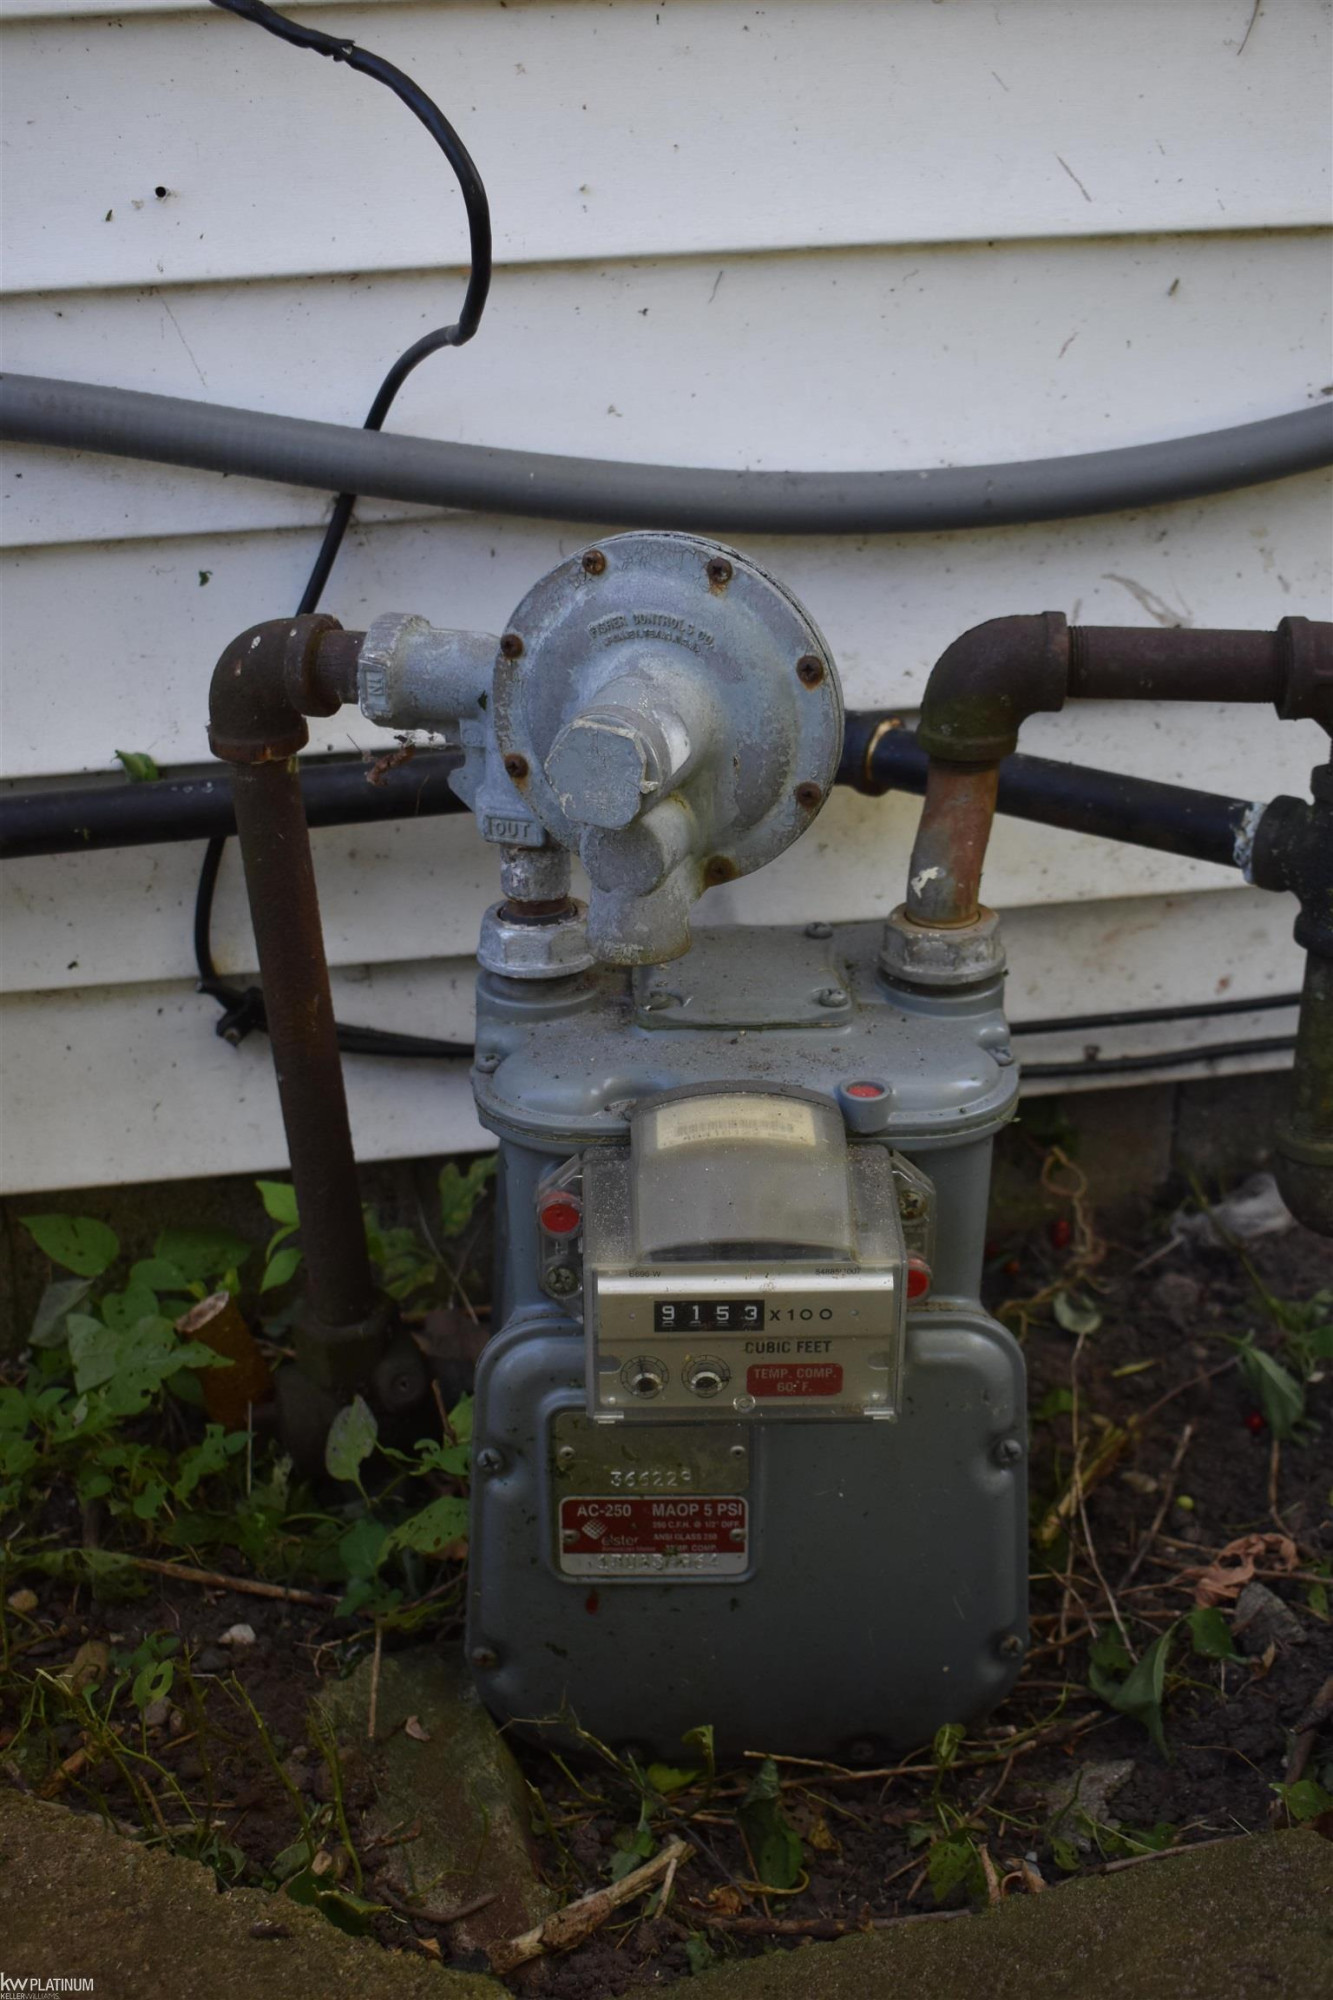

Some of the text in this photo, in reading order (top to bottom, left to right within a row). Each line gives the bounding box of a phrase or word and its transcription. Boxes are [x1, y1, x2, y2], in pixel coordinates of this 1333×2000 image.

[495, 821, 531, 838] OUT
[744, 1340, 832, 1355] CUBIC FEET
[754, 1367, 837, 1379] TEMP. COMP.
[577, 1503, 632, 1518] AC-250
[652, 1503, 743, 1517] MAOP 5 PSI
[601, 1533, 639, 1547] elster
[674, 1532, 702, 1541] CLASS
